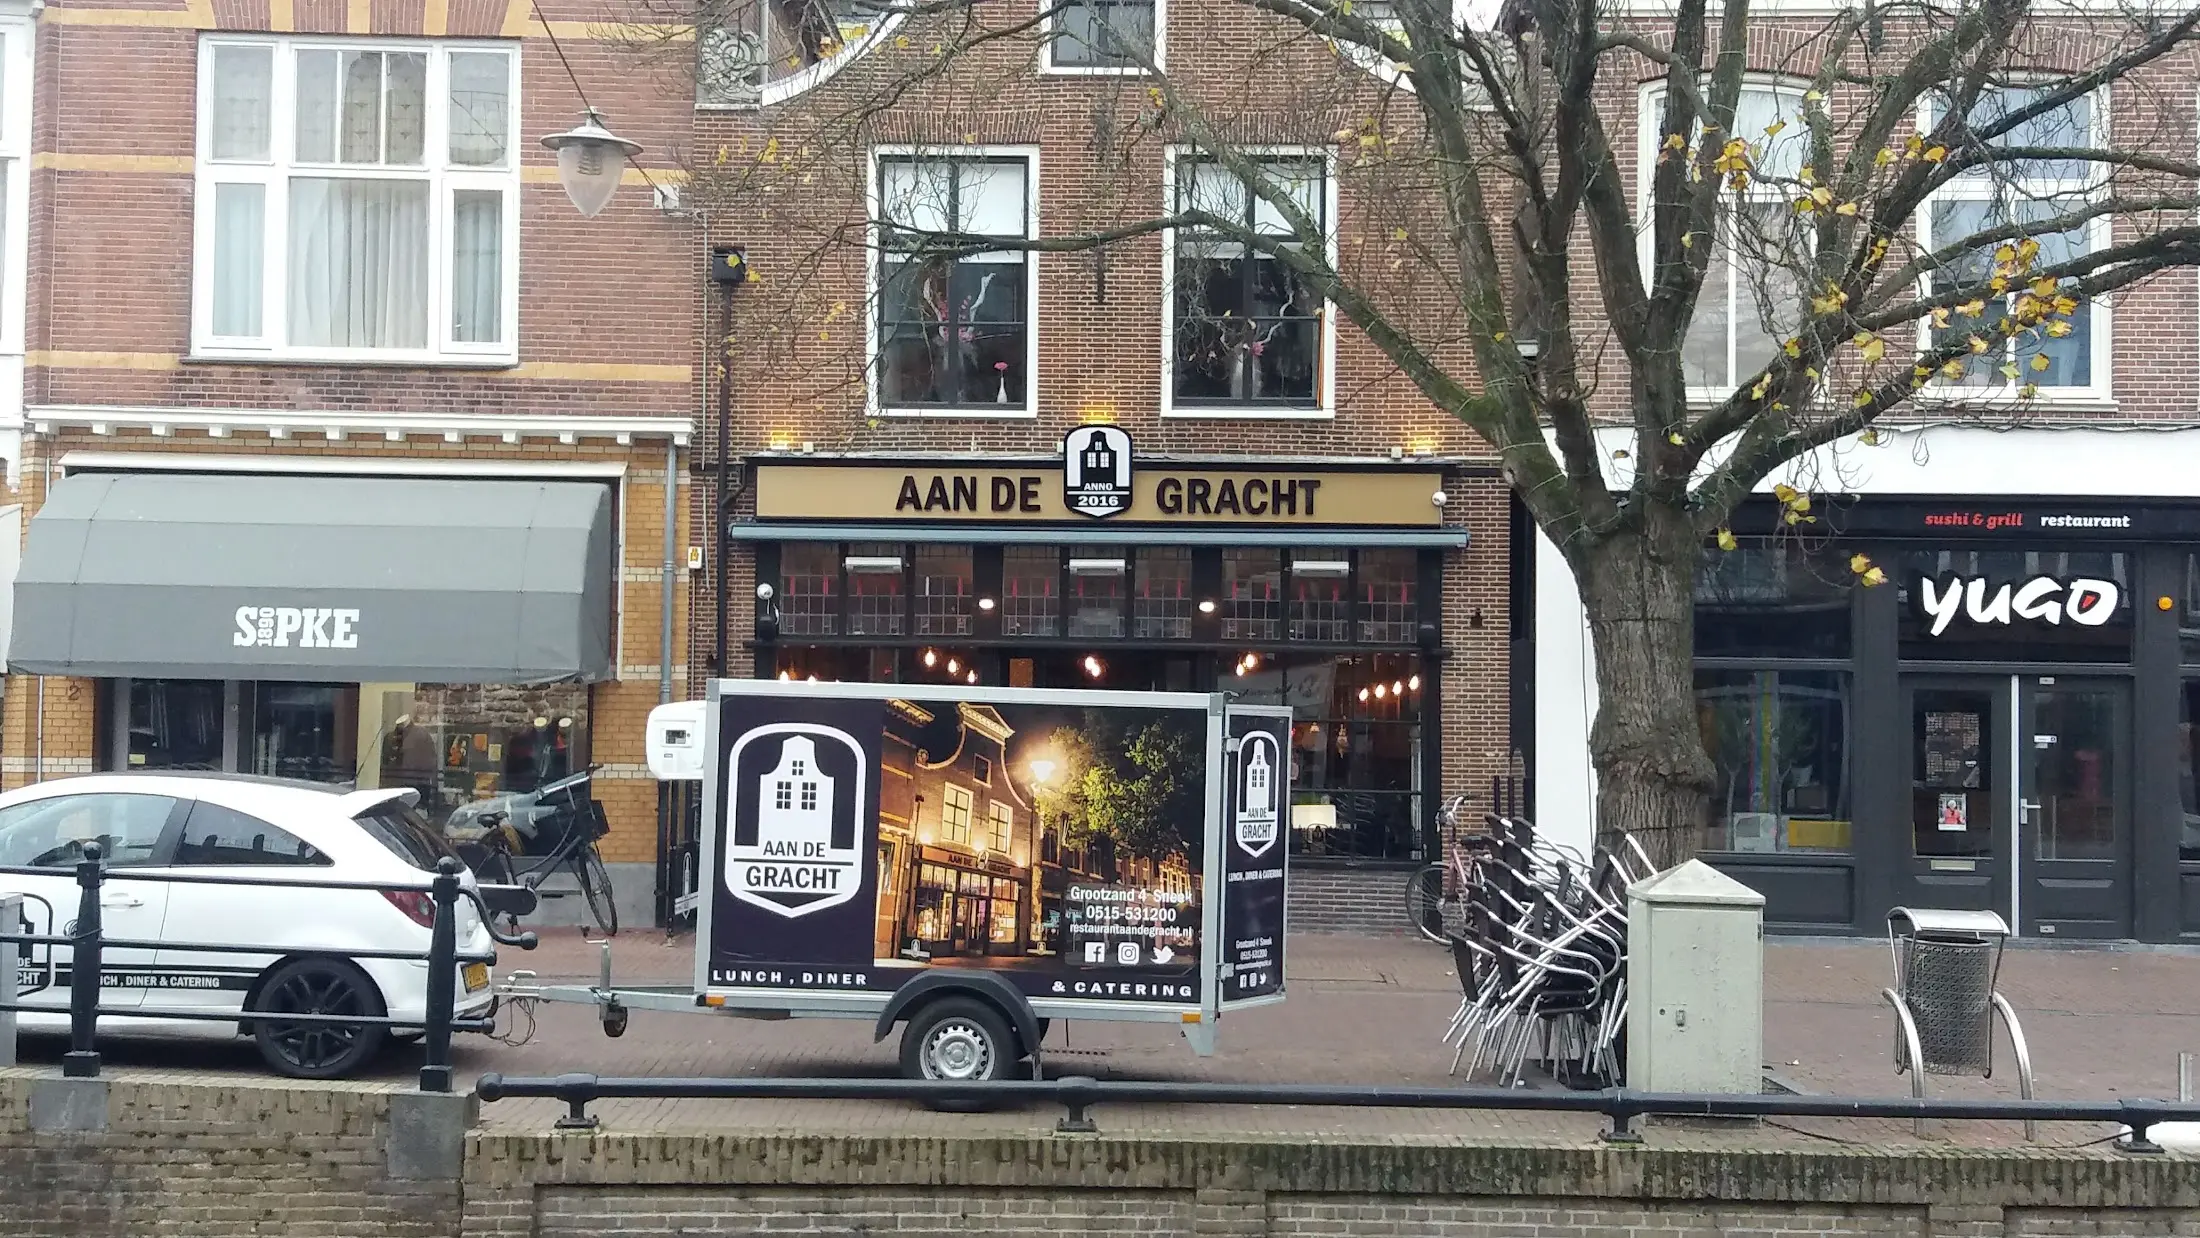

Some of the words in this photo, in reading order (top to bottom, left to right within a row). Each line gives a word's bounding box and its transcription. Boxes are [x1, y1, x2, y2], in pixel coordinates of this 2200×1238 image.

[895, 475, 977, 512] AAN
[991, 477, 1041, 512] DE
[1083, 482, 1113, 491] ANNO
[1077, 495, 1119, 507] 2016
[1156, 478, 1321, 515] GRACHT
[1925, 512, 1969, 526] sushi
[1972, 513, 1983, 526] &
[1986, 512, 2023, 530] grill
[2040, 515, 2131, 528] restaurant
[68, 684, 81, 701] 2
[1247, 808, 1259, 819] AAN
[1242, 824, 1272, 839] GRACHT
[763, 840, 798, 857] AAN
[803, 841, 826, 858] DE
[746, 865, 841, 890] GRACHT
[1070, 886, 1135, 902] Grootzand
[1137, 888, 1147, 903] 4
[1153, 889, 1193, 905] Sneek
[1086, 905, 1176, 922] 0515-531200
[1069, 922, 1193, 938] restaurantaandegracht.nl
[17, 957, 32, 968] DE
[16, 971, 41, 985] CHT
[126, 976, 157, 986] DINER
[160, 976, 168, 986] &
[170, 976, 220, 988] CATERING
[712, 969, 782, 983] LUNCH
[802, 973, 867, 985] DINER
[1052, 981, 1066, 993] &
[1074, 981, 1193, 997] CATERING
